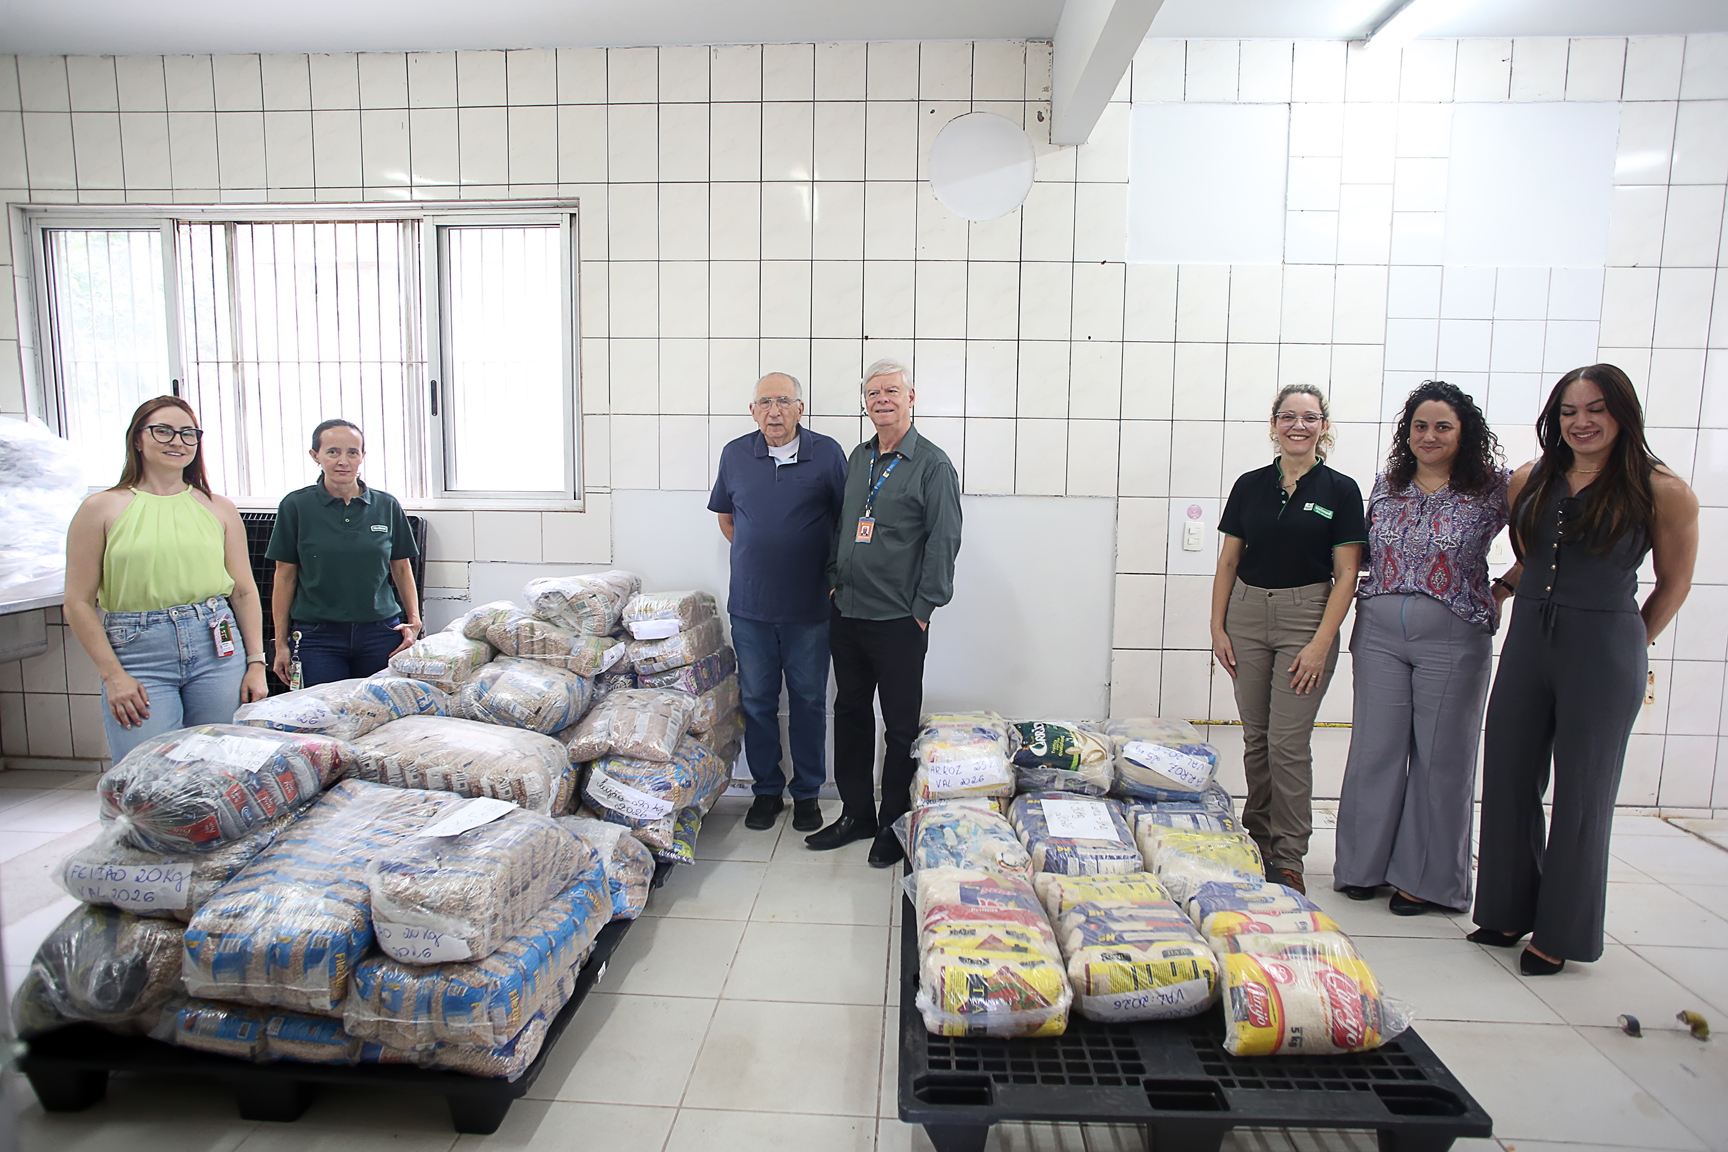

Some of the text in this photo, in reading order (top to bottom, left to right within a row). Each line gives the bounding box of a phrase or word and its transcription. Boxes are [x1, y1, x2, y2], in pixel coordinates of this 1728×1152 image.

[930, 765, 962, 776] ARROZ
[1167, 762, 1205, 787] ARROZ
[960, 774, 985, 786] 2026
[615, 803, 647, 818] 2026
[70, 865, 127, 882] FEIJÃO
[111, 888, 155, 902] 2026
[1114, 995, 1149, 1010] 2026
